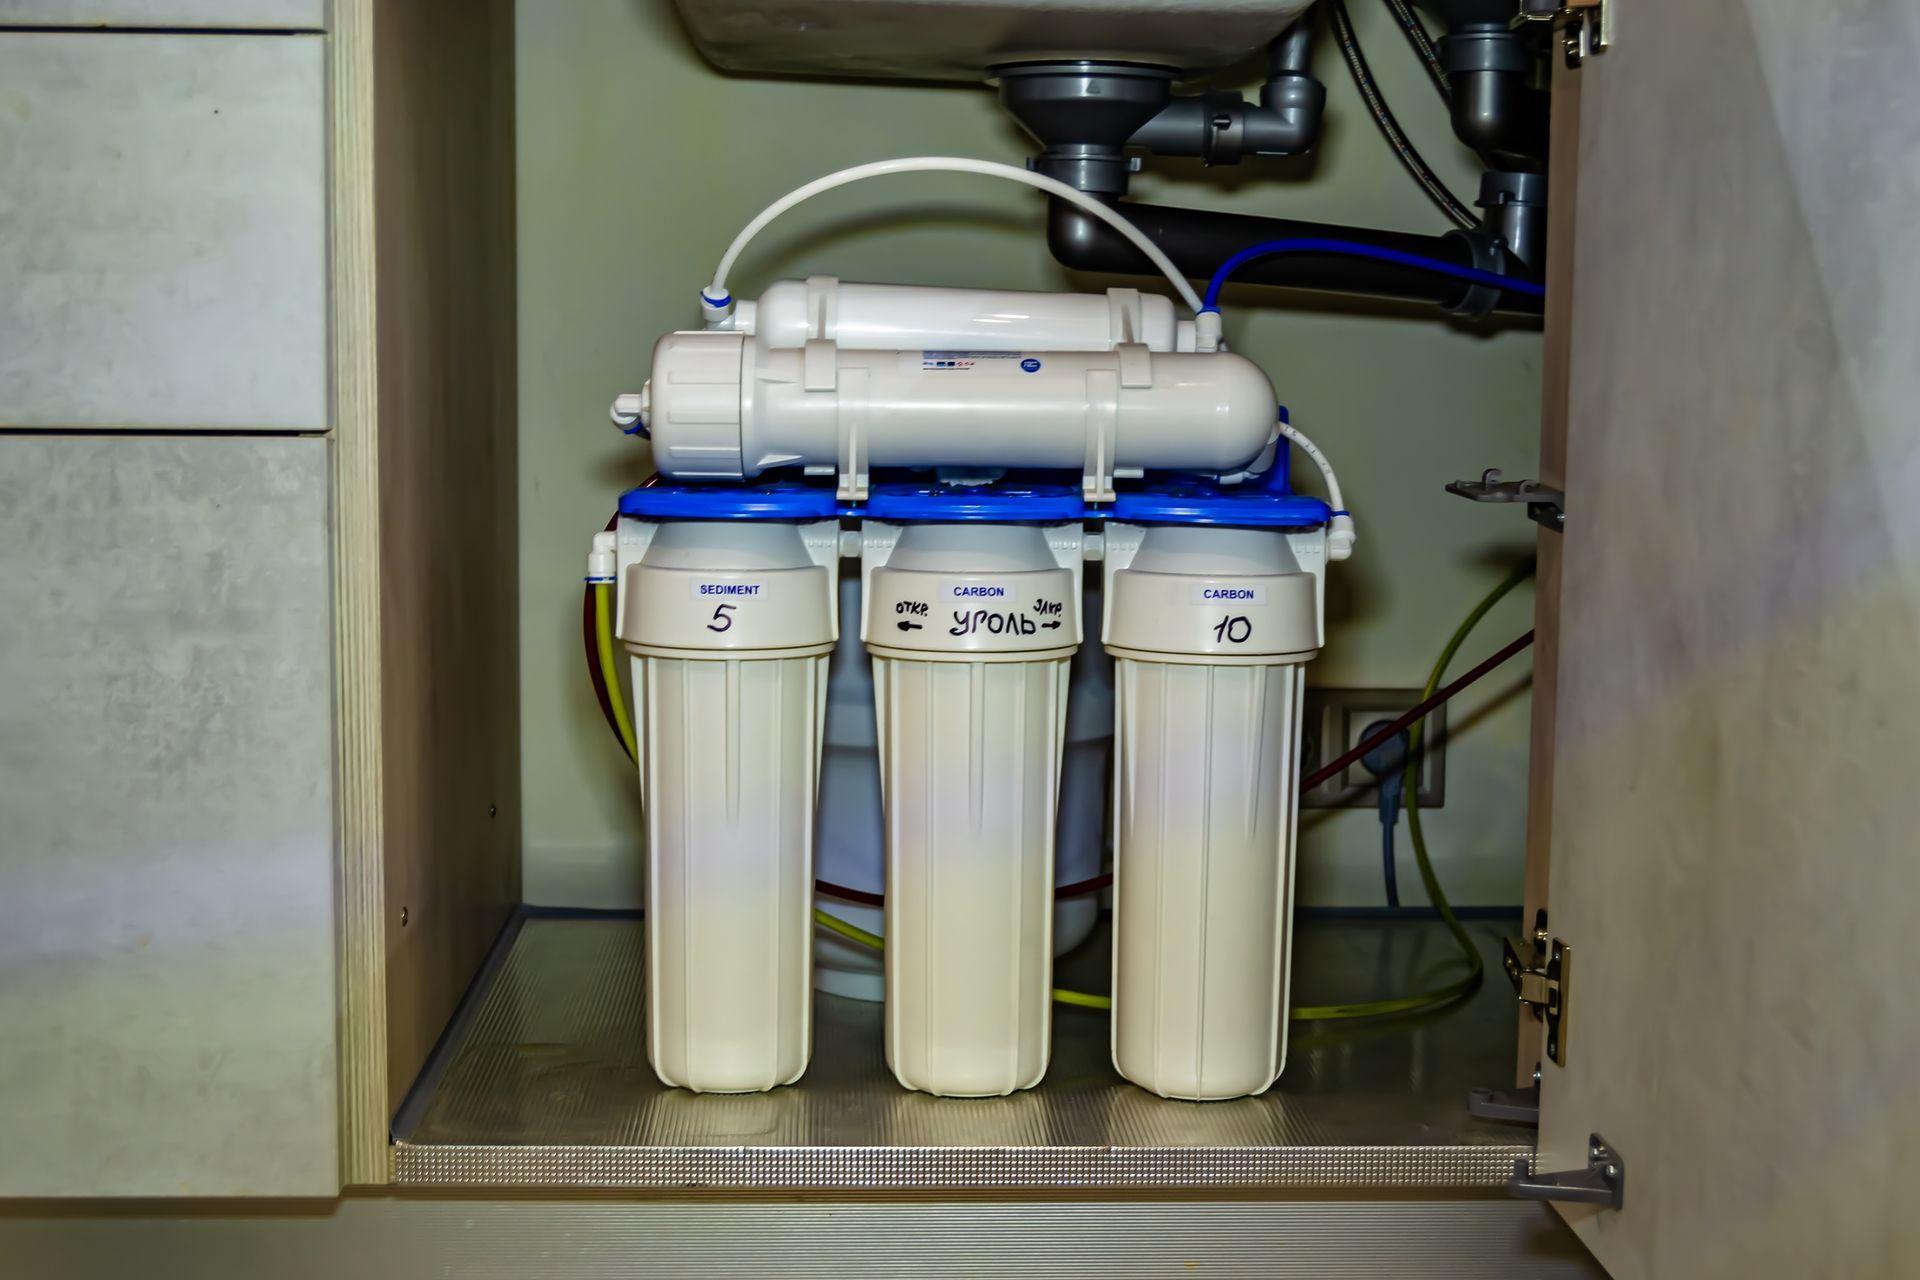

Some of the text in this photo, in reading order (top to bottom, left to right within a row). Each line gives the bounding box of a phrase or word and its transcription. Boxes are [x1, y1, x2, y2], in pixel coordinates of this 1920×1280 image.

[700, 584, 760, 595] SEDIMENT
[953, 586, 1004, 597] CARBON
[1203, 589, 1254, 599] CARBON
[706, 603, 737, 633] 5
[1213, 615, 1252, 643] 10
